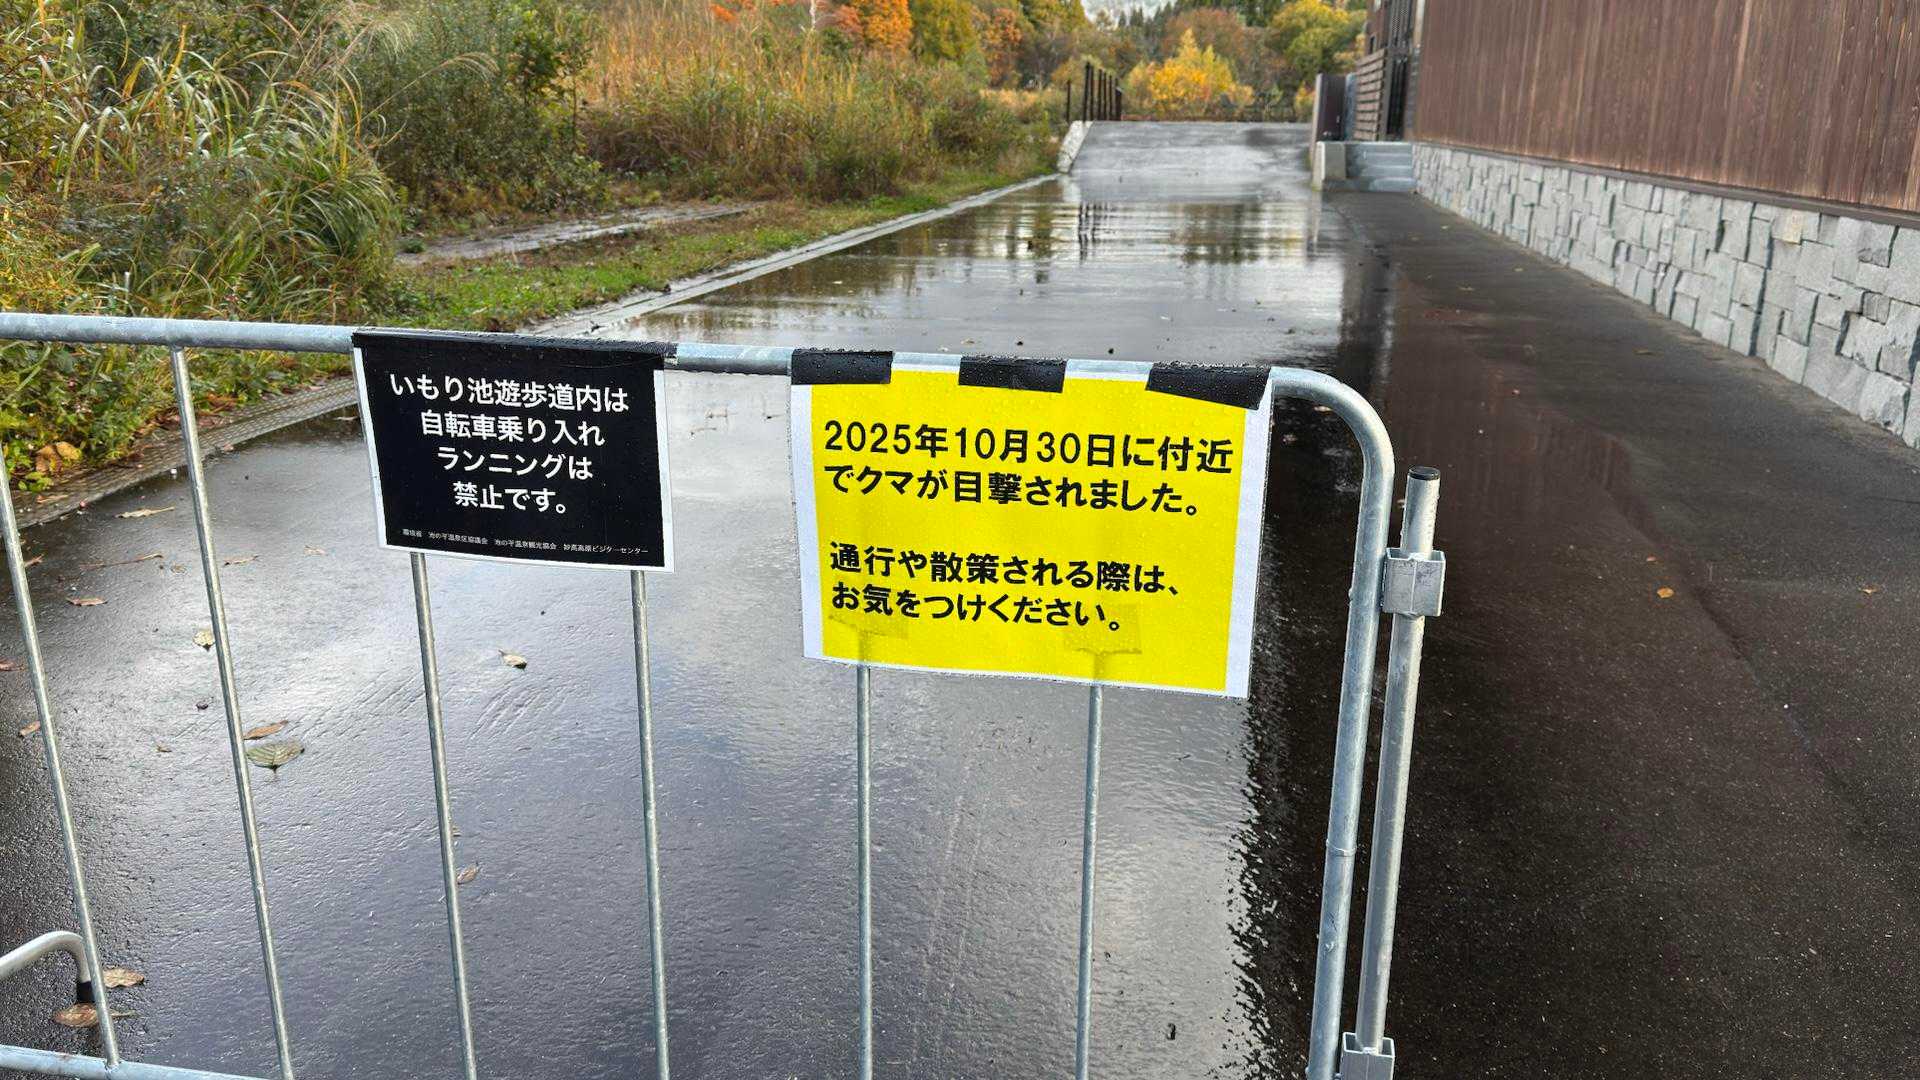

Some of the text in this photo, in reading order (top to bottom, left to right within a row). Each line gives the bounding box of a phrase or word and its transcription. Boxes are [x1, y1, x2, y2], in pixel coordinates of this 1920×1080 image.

[390, 374, 630, 413] いもり池遊歩道内は
[421, 408, 606, 447] 自転車乗り入れ
[825, 419, 1234, 474] 2025年10月30日に付近
[438, 446, 594, 480] ランニングは
[453, 481, 569, 515] 禁止です。
[825, 464, 1199, 517] でクマが目撃されました。
[830, 541, 1180, 597] 通行や散策される際は、
[831, 581, 1121, 632] お気をつけください。
